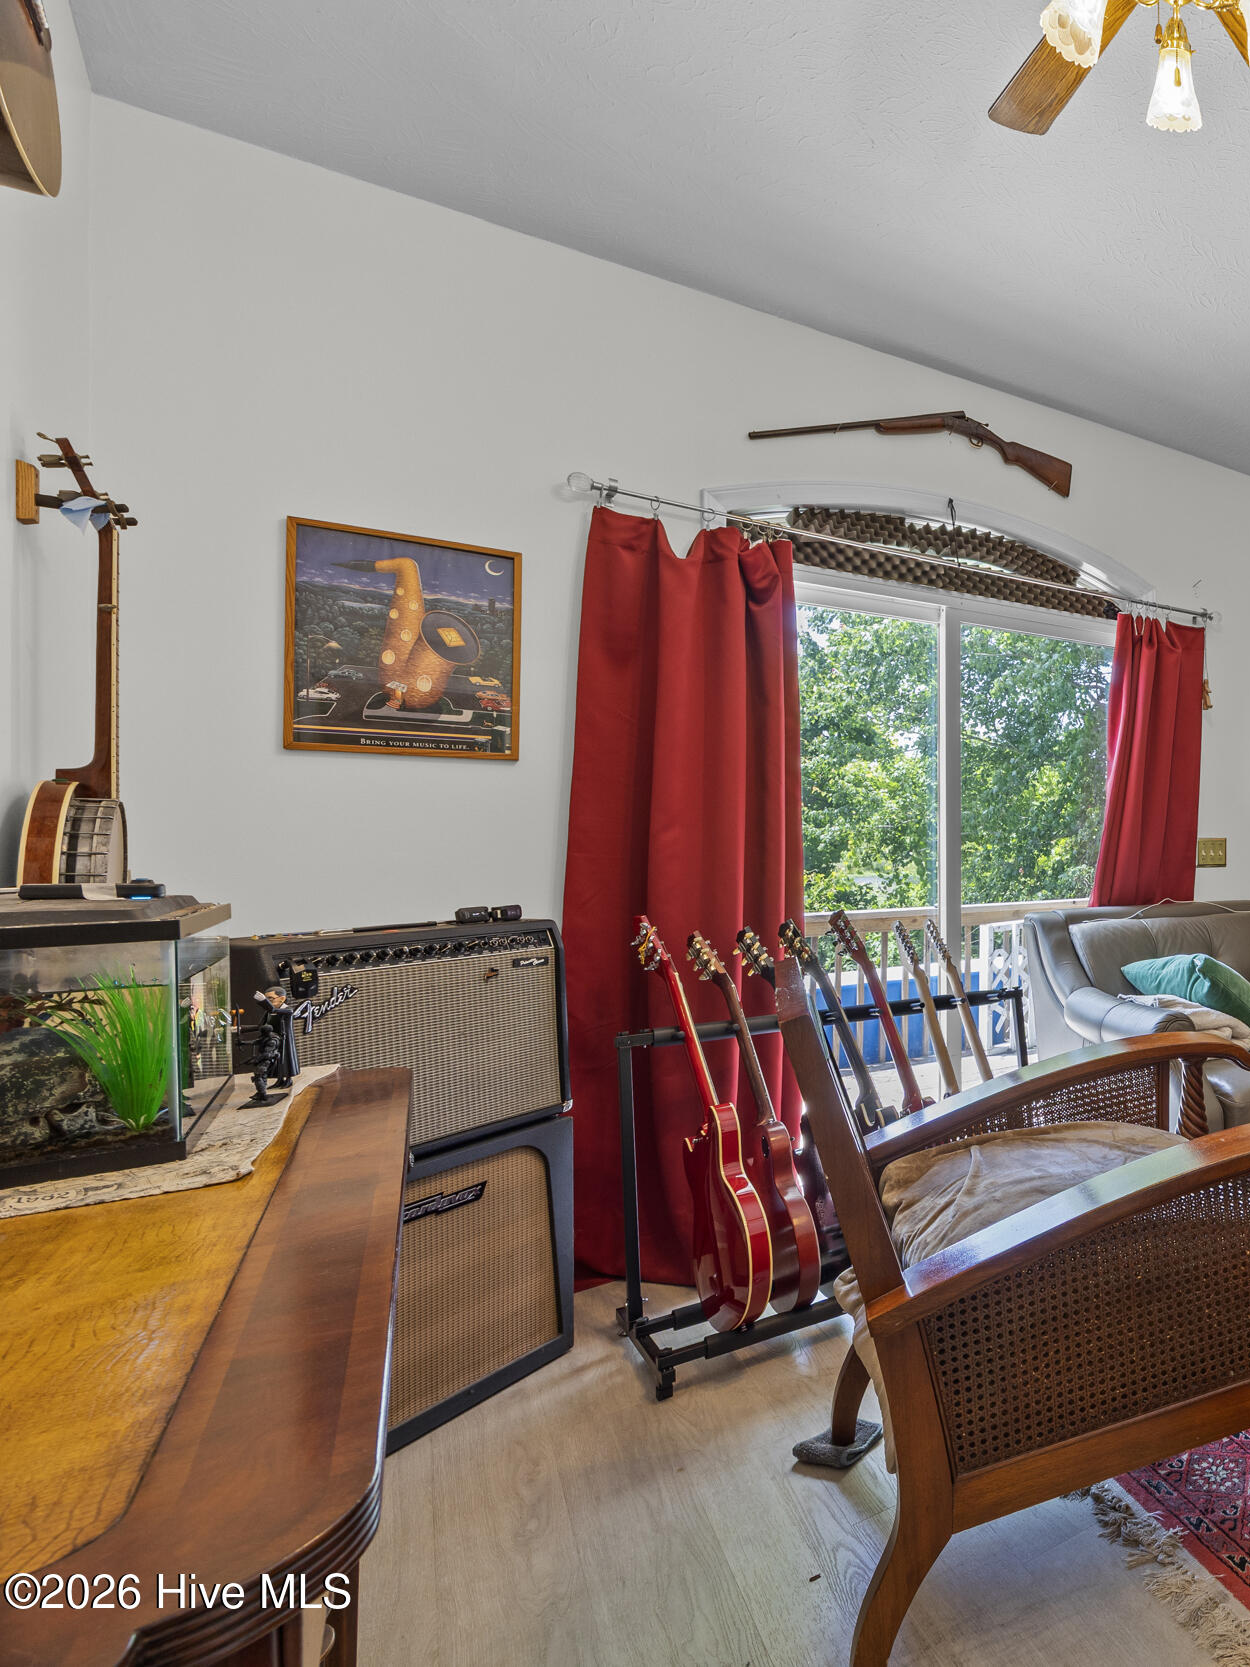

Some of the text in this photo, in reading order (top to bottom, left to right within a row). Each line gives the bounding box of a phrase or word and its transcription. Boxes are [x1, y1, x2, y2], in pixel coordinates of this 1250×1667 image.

[360, 737, 387, 746] BRING
[389, 739, 410, 747] YOUR
[292, 985, 358, 1033] Fender
